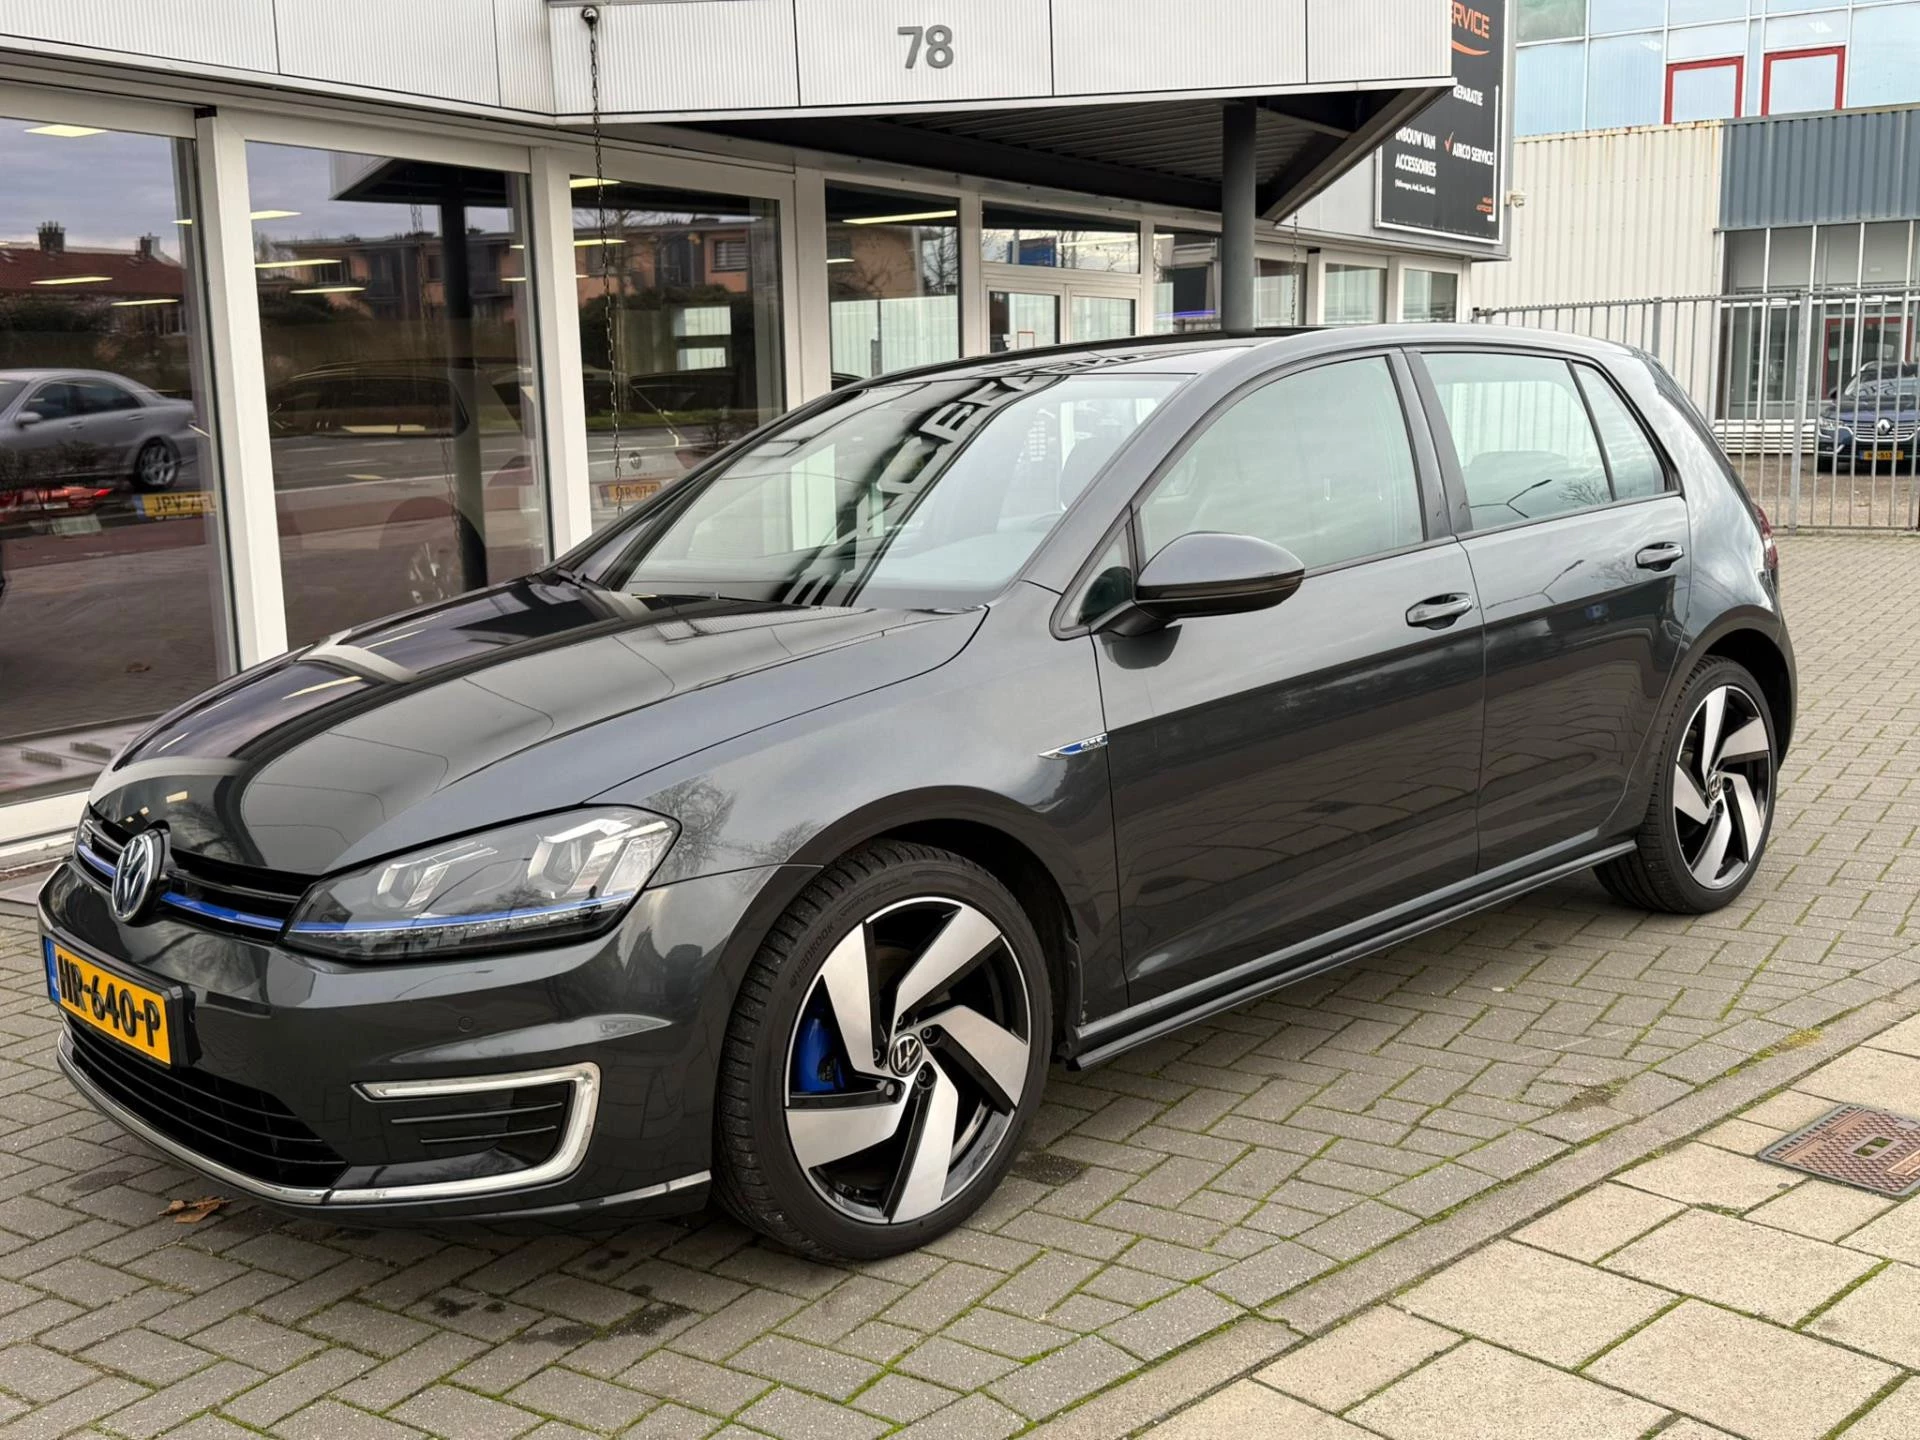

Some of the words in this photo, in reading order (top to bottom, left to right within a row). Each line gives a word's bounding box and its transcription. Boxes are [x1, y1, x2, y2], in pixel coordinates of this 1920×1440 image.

[1452, 1, 1490, 39] RVICE
[897, 25, 955, 70] 78
[1422, 132, 1436, 150] VAN
[1452, 142, 1471, 160] AIRCO
[1471, 146, 1494, 165] SERVICE
[1395, 153, 1437, 177] ACCESSOIRES
[57, 954, 161, 1048] HR-640-P
